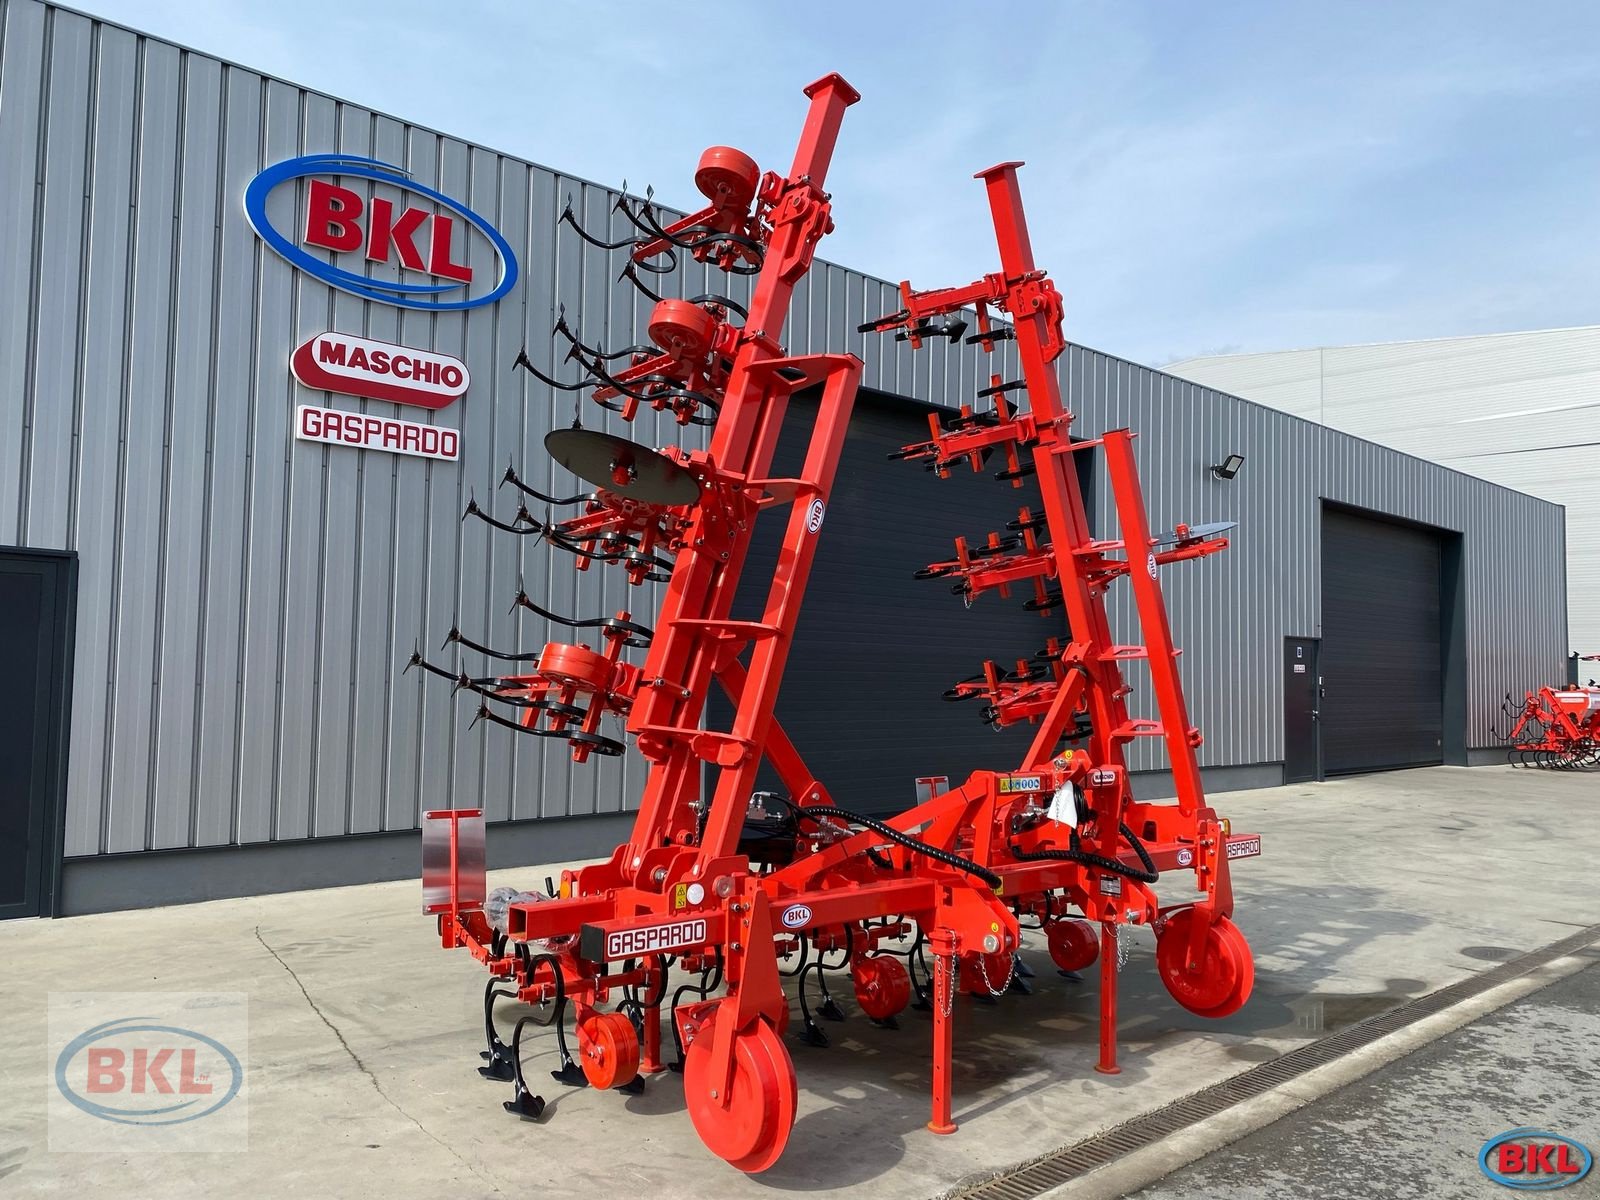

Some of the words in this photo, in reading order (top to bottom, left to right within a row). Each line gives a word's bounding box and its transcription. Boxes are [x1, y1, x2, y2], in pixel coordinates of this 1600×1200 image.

[304, 179, 472, 283] BKL
[319, 340, 463, 388] MASCHIO
[302, 408, 458, 457] GASPARDO
[810, 505, 822, 528] BKL
[1227, 841, 1259, 857] ASPARDO
[788, 909, 808, 922] BKL
[609, 921, 705, 955] GASPARDO
